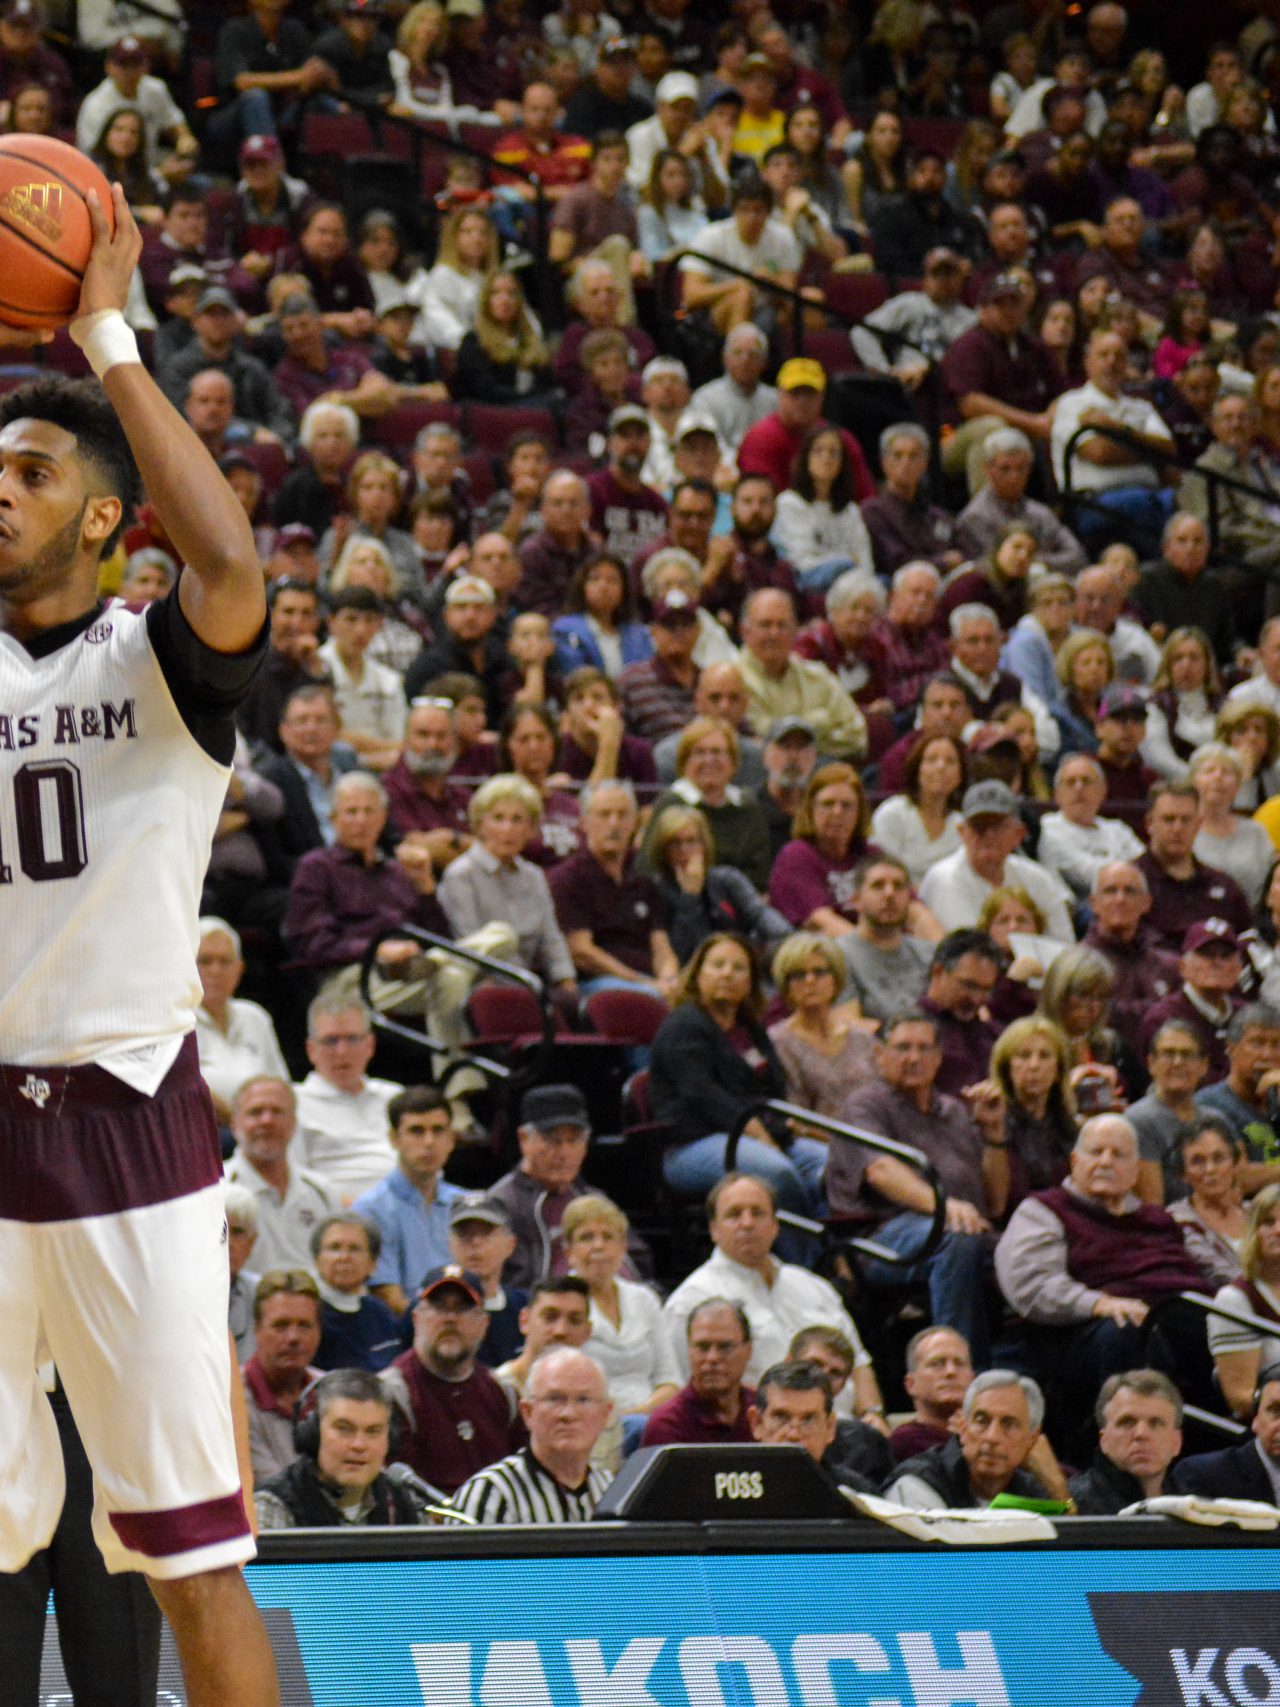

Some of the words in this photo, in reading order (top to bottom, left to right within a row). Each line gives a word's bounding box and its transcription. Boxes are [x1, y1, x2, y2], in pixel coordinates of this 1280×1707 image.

[54, 698, 138, 745] A&M
[715, 1471, 763, 1499] POSS
[1169, 1647, 1280, 1707] KO
